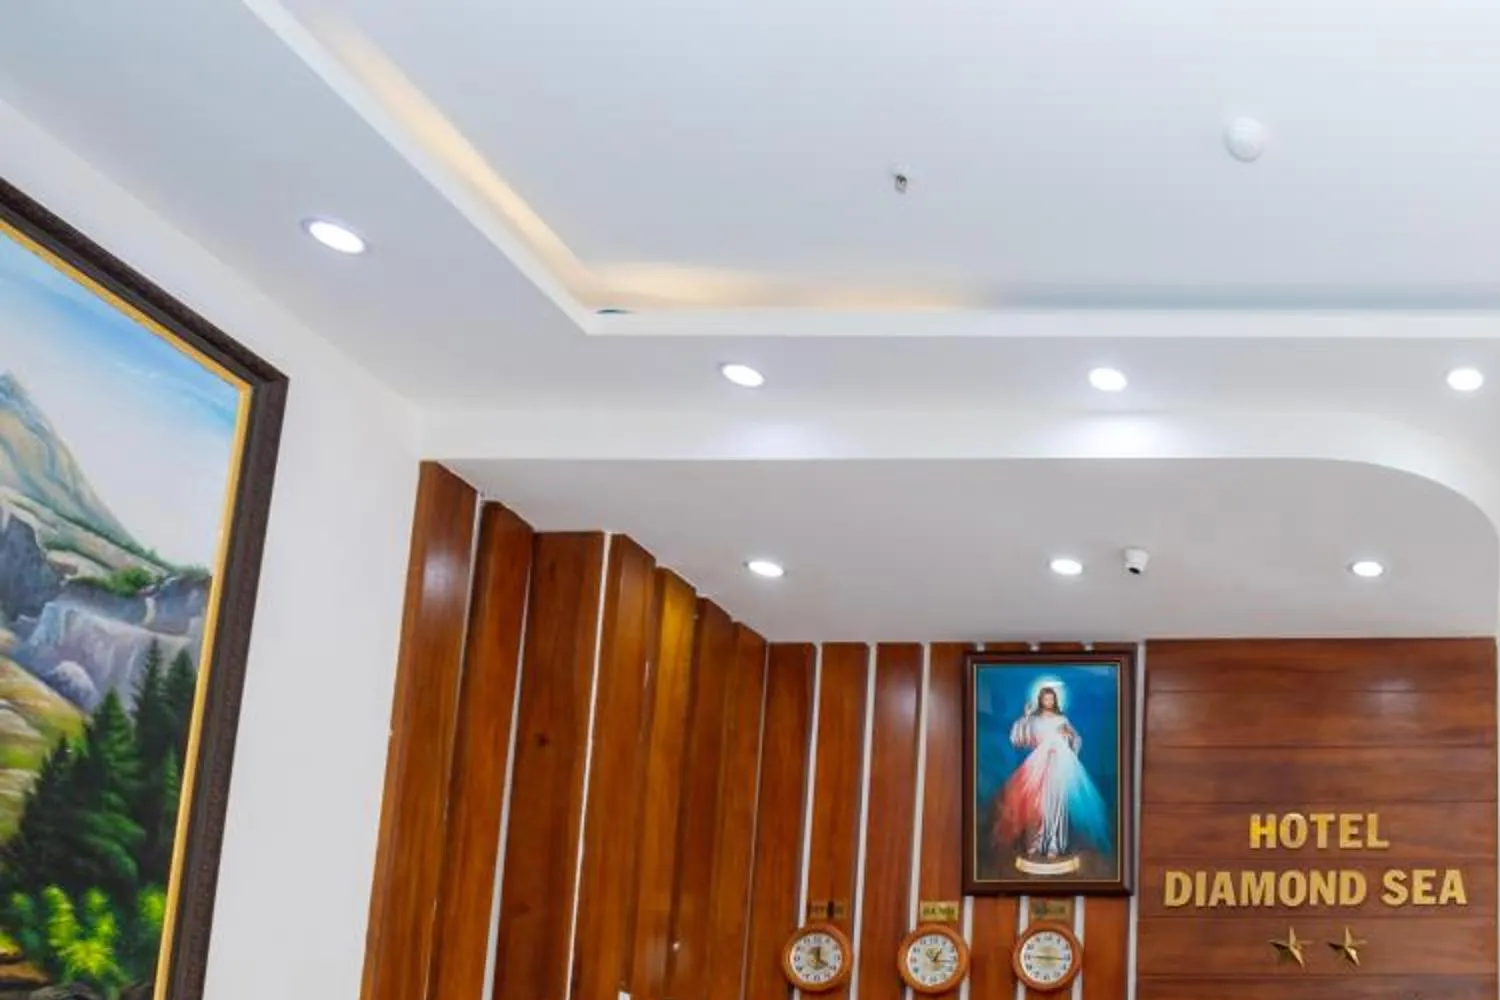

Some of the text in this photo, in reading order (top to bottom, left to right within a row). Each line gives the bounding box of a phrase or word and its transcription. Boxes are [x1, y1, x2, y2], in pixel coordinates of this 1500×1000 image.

[1249, 813, 1390, 849] HOTEL
[1164, 868, 1468, 907] DIAMOND SEA
